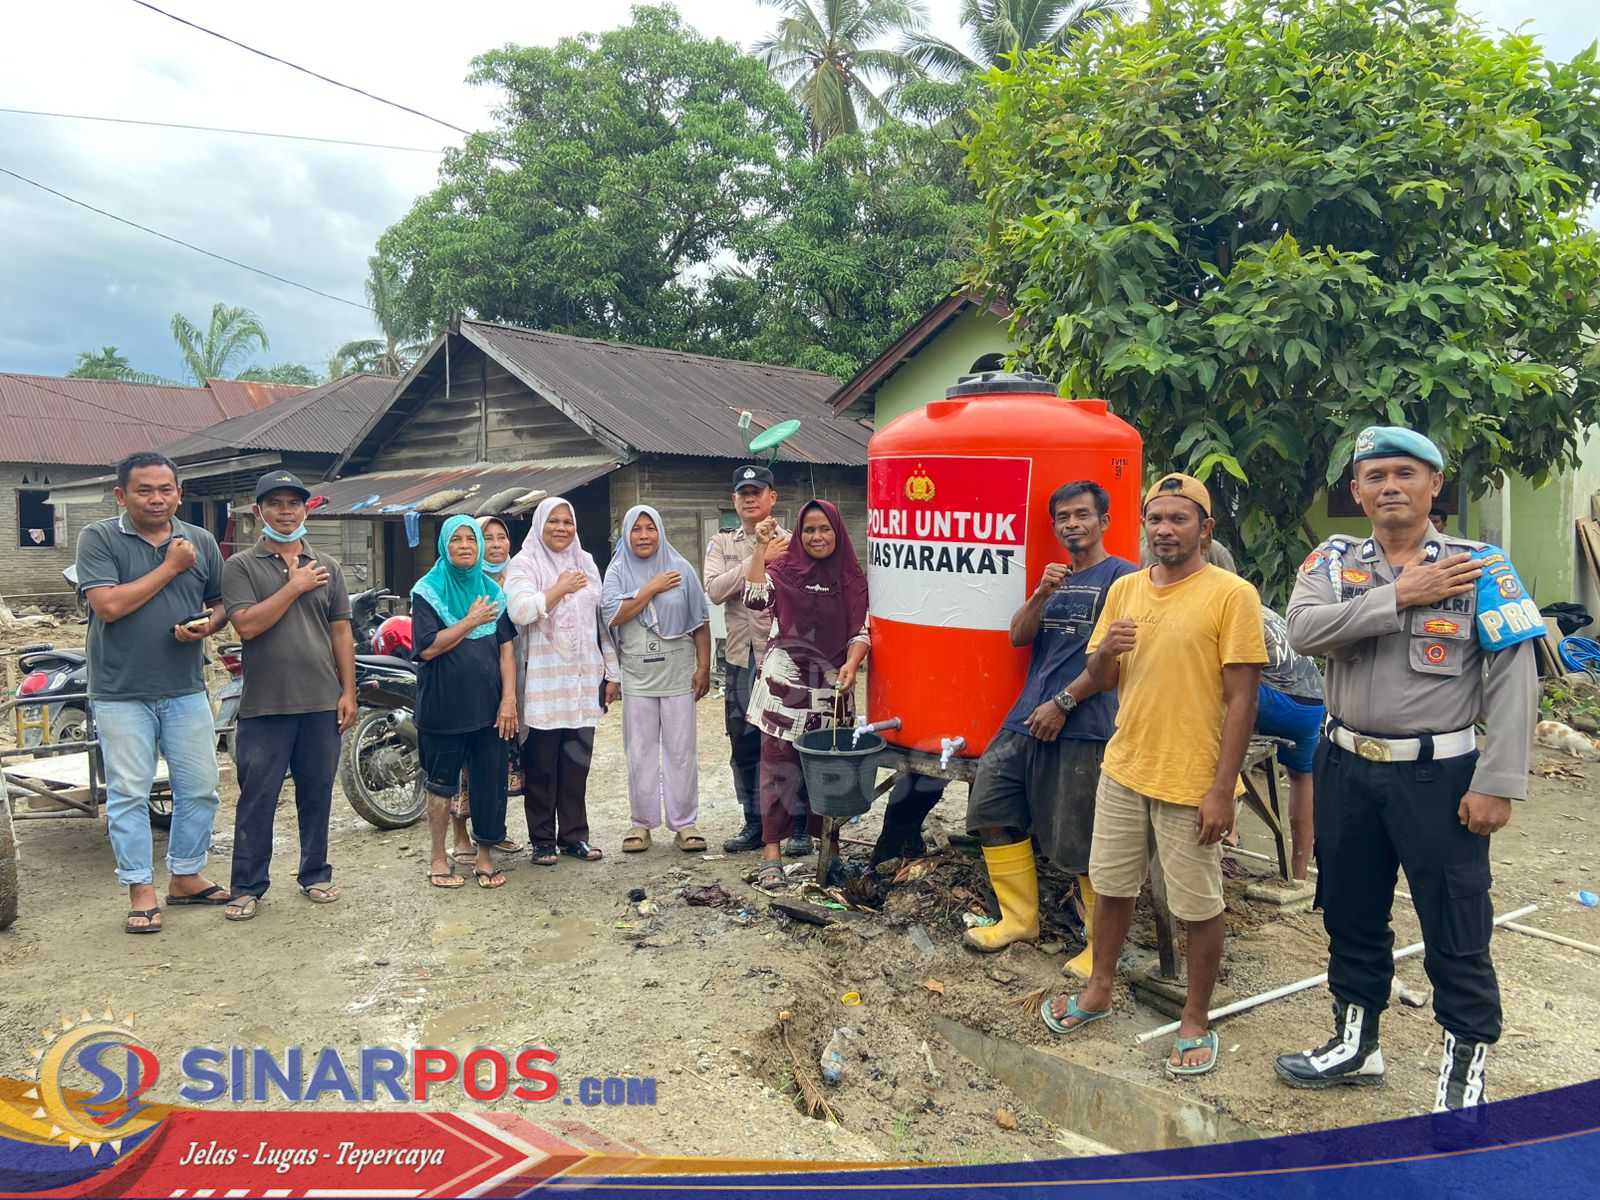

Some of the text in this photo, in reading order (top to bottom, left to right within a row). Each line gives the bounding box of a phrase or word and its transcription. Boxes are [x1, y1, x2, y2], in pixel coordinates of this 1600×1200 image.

[868, 508, 1017, 541] POLRI UNTUK
[1431, 599, 1470, 613] OLRI
